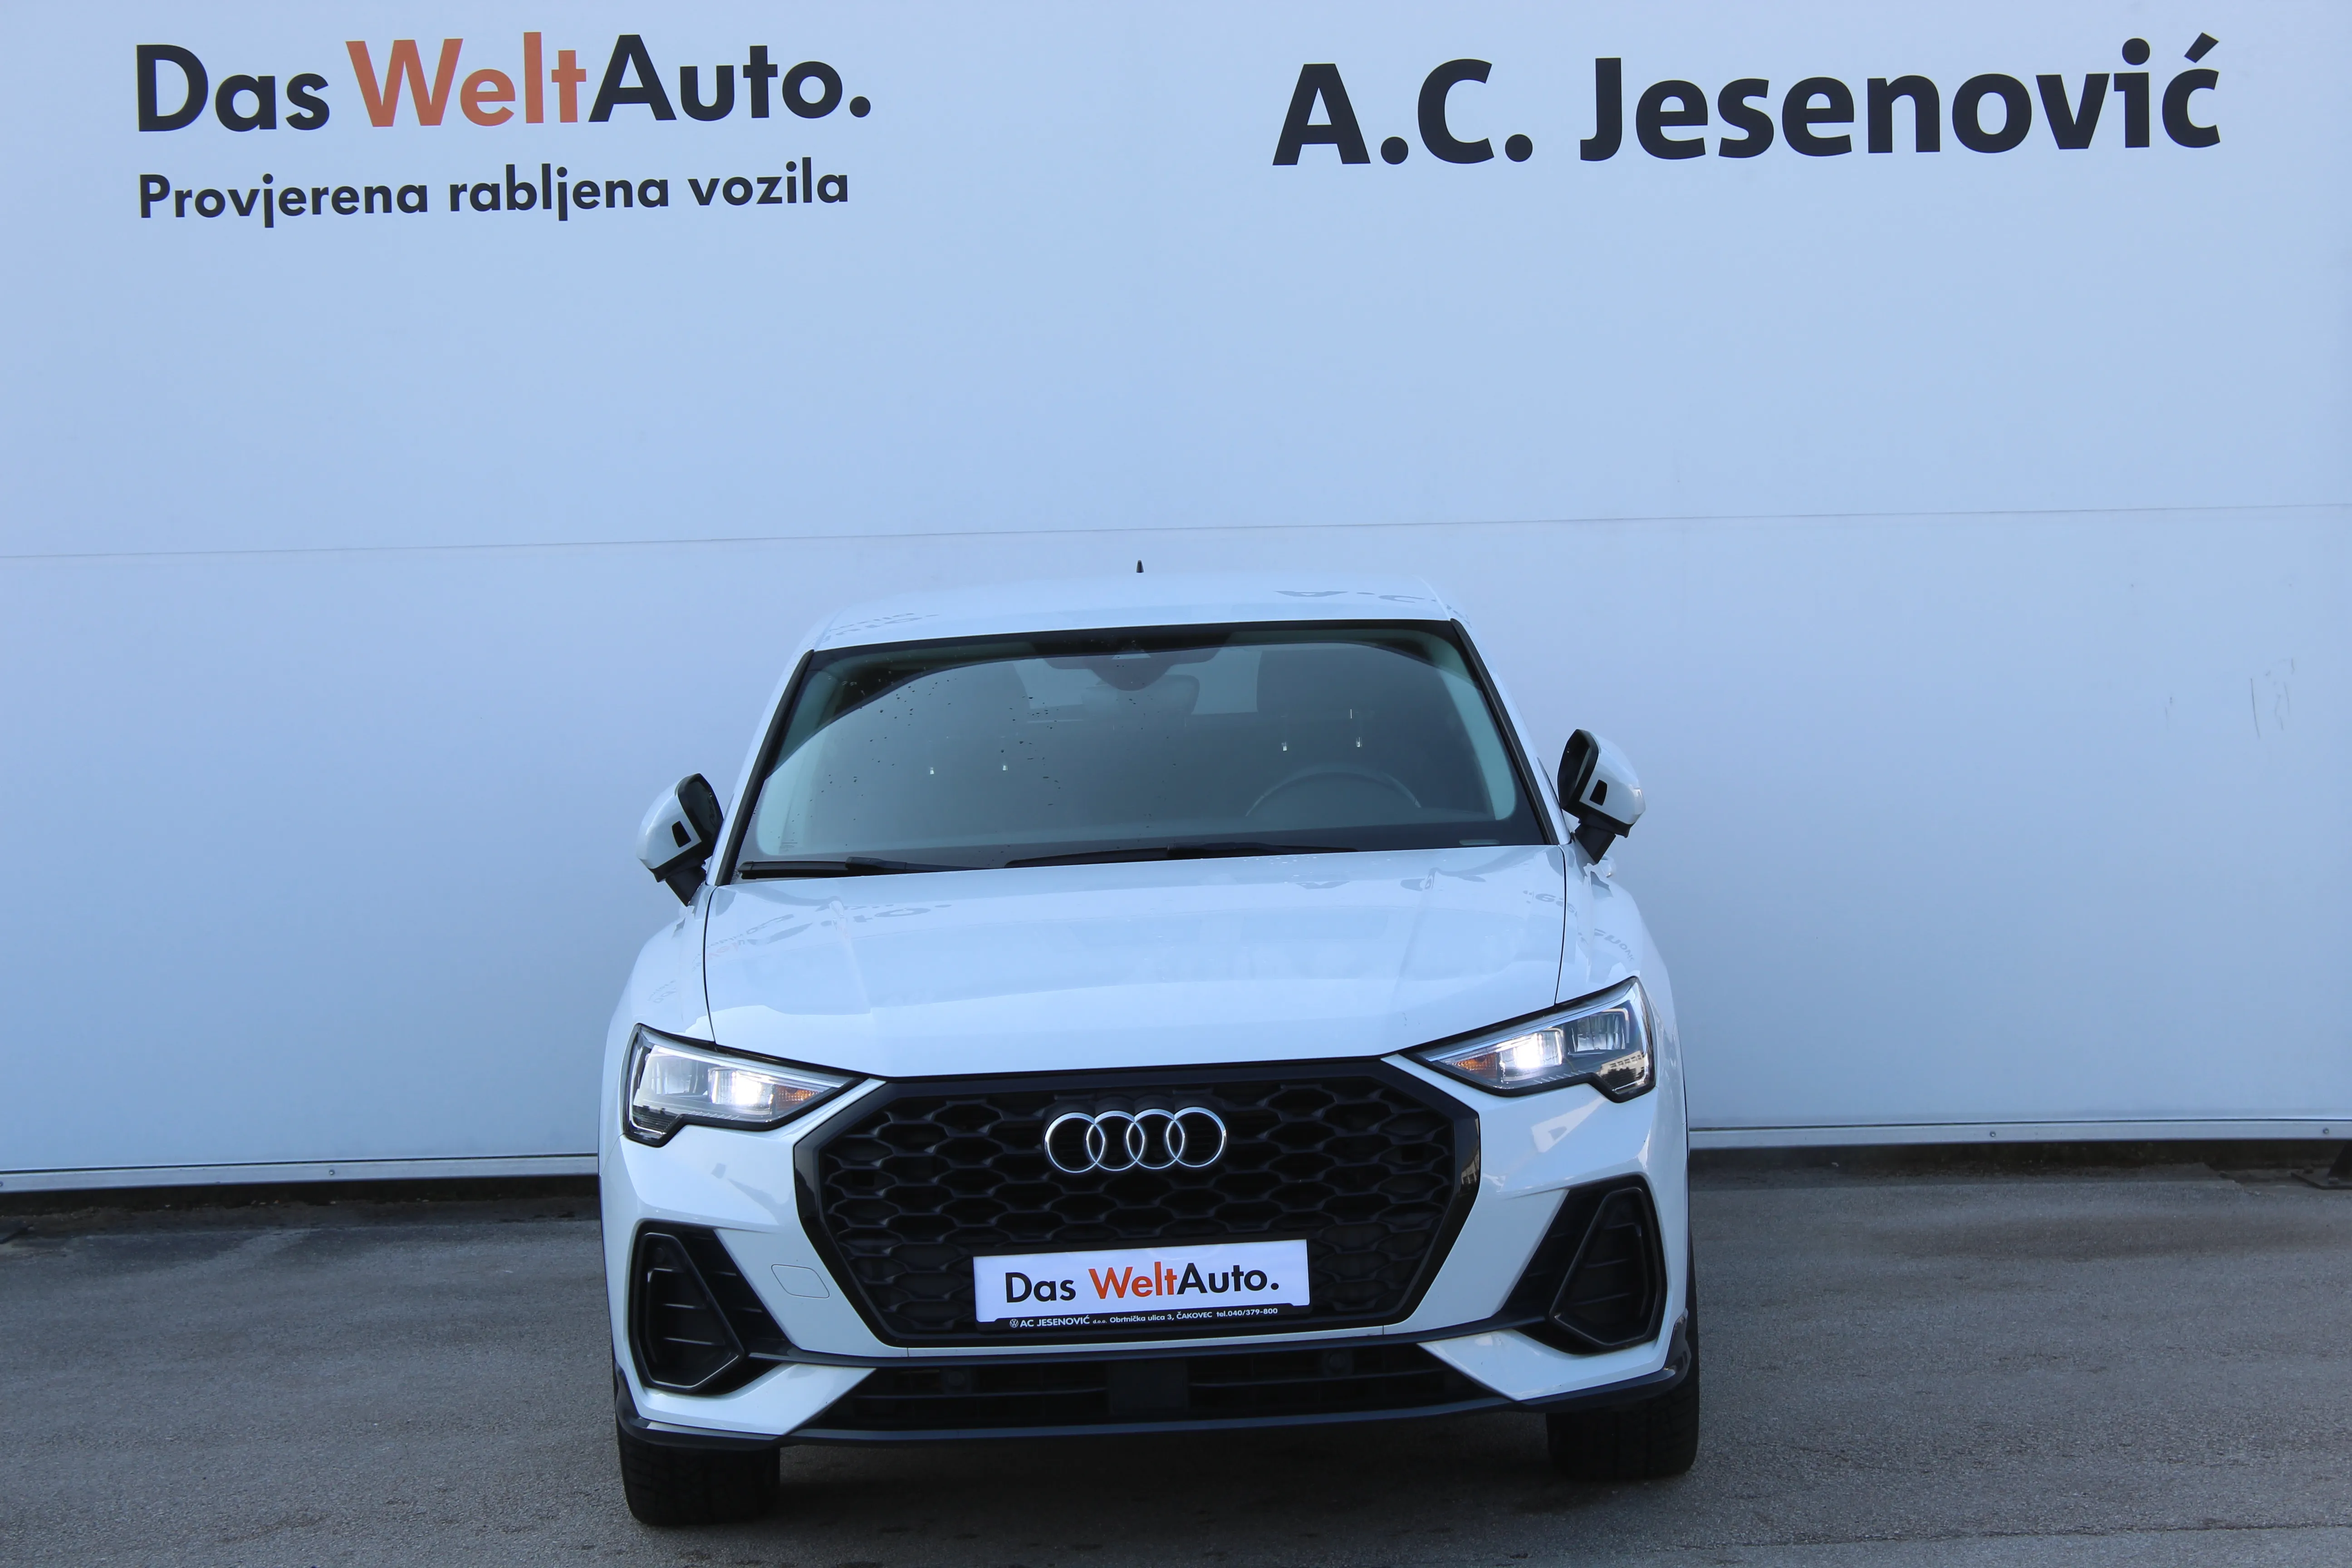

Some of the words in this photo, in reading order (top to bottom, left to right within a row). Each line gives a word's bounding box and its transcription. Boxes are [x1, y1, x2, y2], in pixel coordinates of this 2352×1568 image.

[136, 44, 330, 132] Das
[345, 31, 871, 127] WeltAuto.
[1272, 59, 1533, 166] A.C.
[1580, 32, 2220, 162] Jesenović
[139, 173, 427, 228] Provjerena
[449, 163, 669, 221] rabljena
[687, 157, 848, 206] vozila
[1005, 1272, 1076, 1303] Das
[1088, 1261, 1279, 1299] WeltAuto.
[1019, 1319, 1034, 1328] AC
[1037, 1315, 1090, 1327] JESENOVIĆ
[1109, 1315, 1146, 1323] Obrtnička
[1176, 1311, 1213, 1320] ČAKOVEC
[1216, 1308, 1278, 1318] tel.040/379-800
